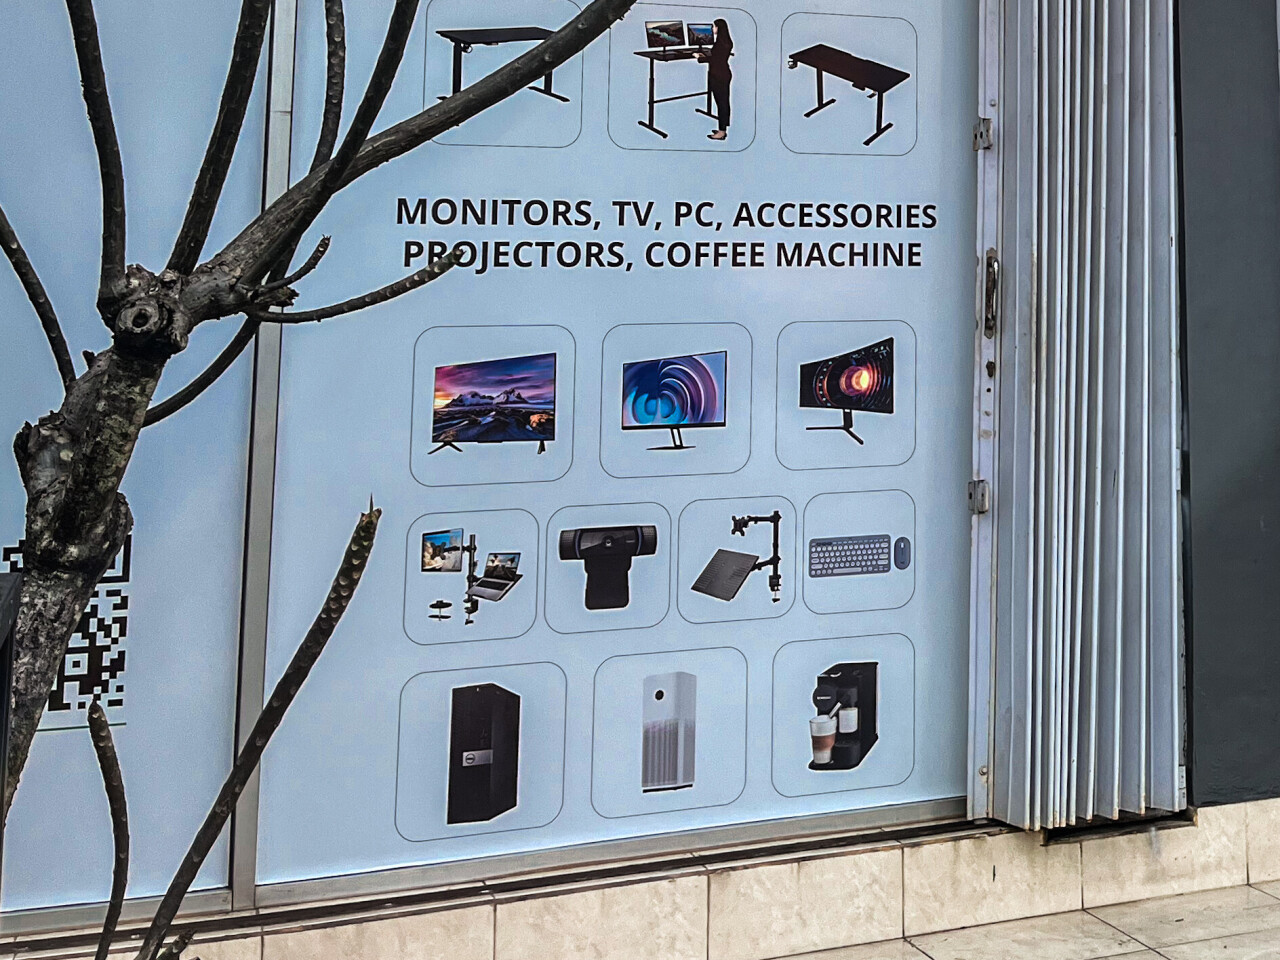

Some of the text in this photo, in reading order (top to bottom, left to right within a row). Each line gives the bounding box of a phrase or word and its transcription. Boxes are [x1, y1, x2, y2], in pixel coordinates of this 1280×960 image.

[396, 197, 937, 233] MONITORS, TV, PC, ACCESSORIES
[404, 240, 923, 275] PROJECTORS, COFFEE MACHINE
